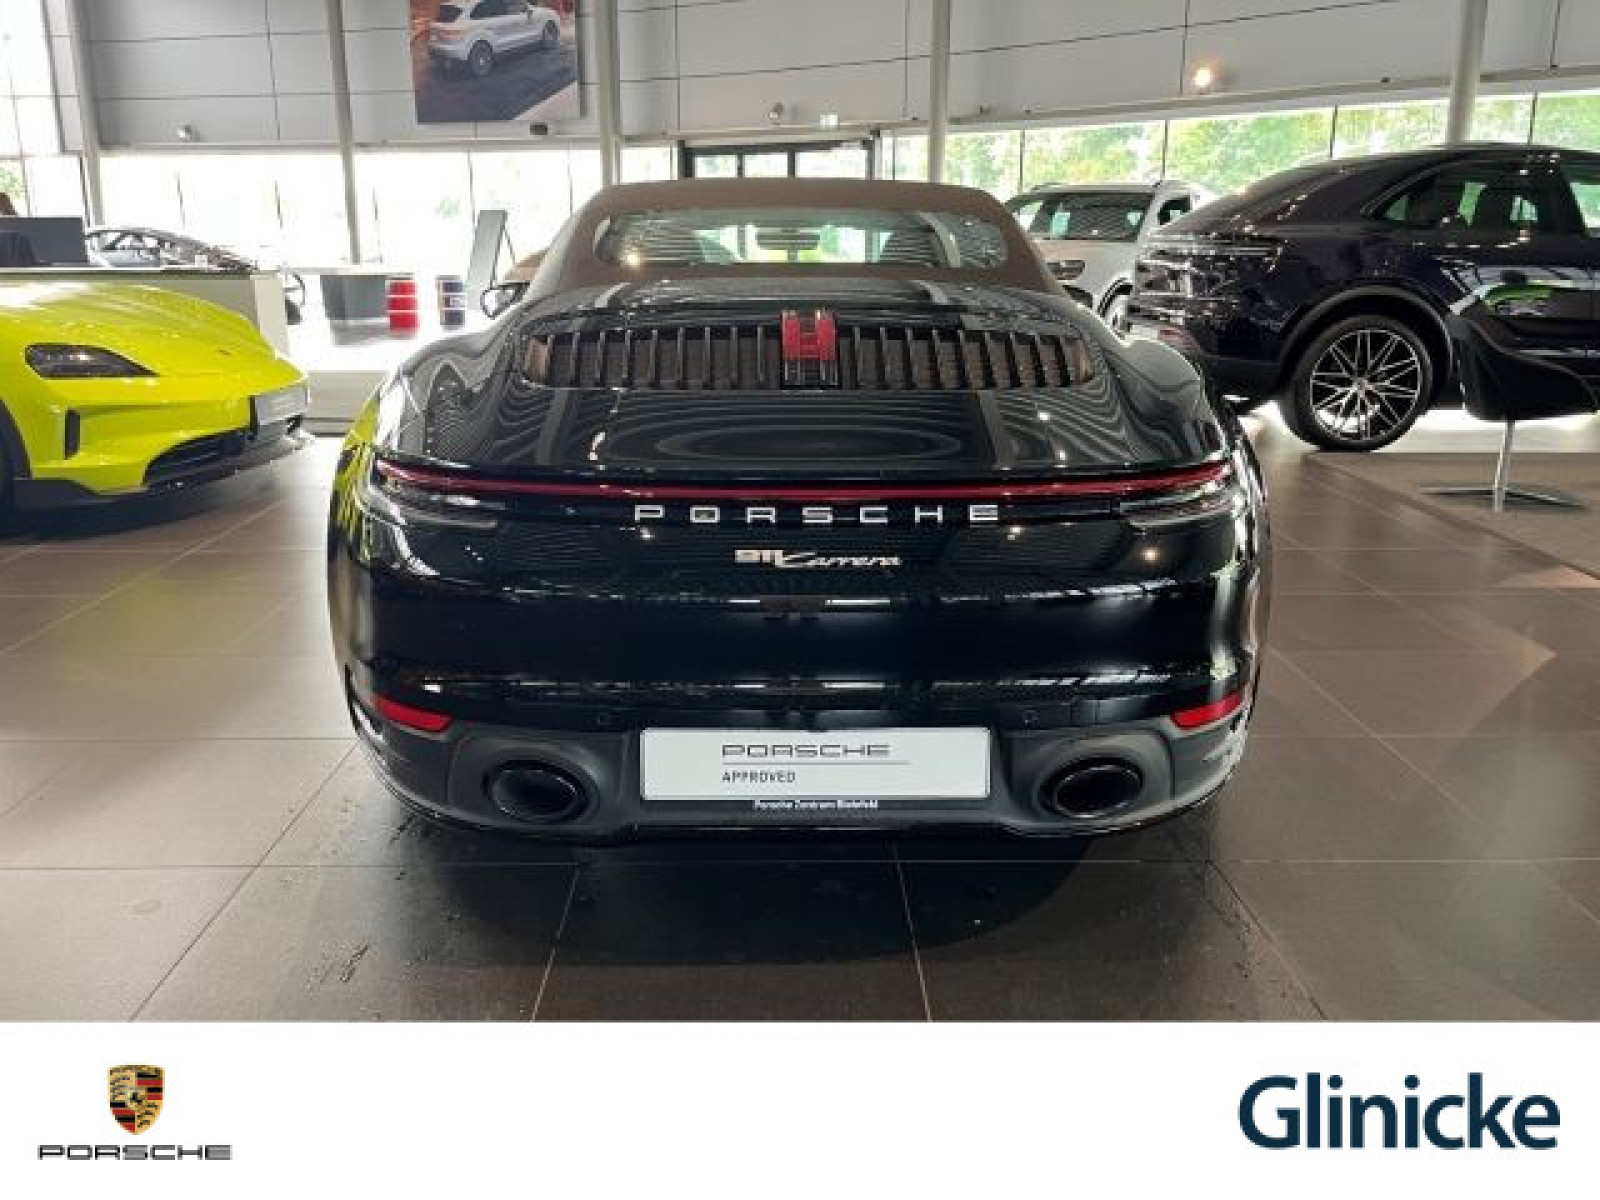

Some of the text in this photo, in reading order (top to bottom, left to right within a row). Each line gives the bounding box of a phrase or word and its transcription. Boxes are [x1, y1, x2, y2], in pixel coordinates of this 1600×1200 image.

[634, 504, 1002, 524] PORSCHE
[775, 551, 902, 569] Carrera
[721, 744, 891, 759] PORSCHE
[721, 771, 796, 784] APPROVED
[754, 799, 793, 811] Porsche
[795, 799, 836, 810] Zentrum
